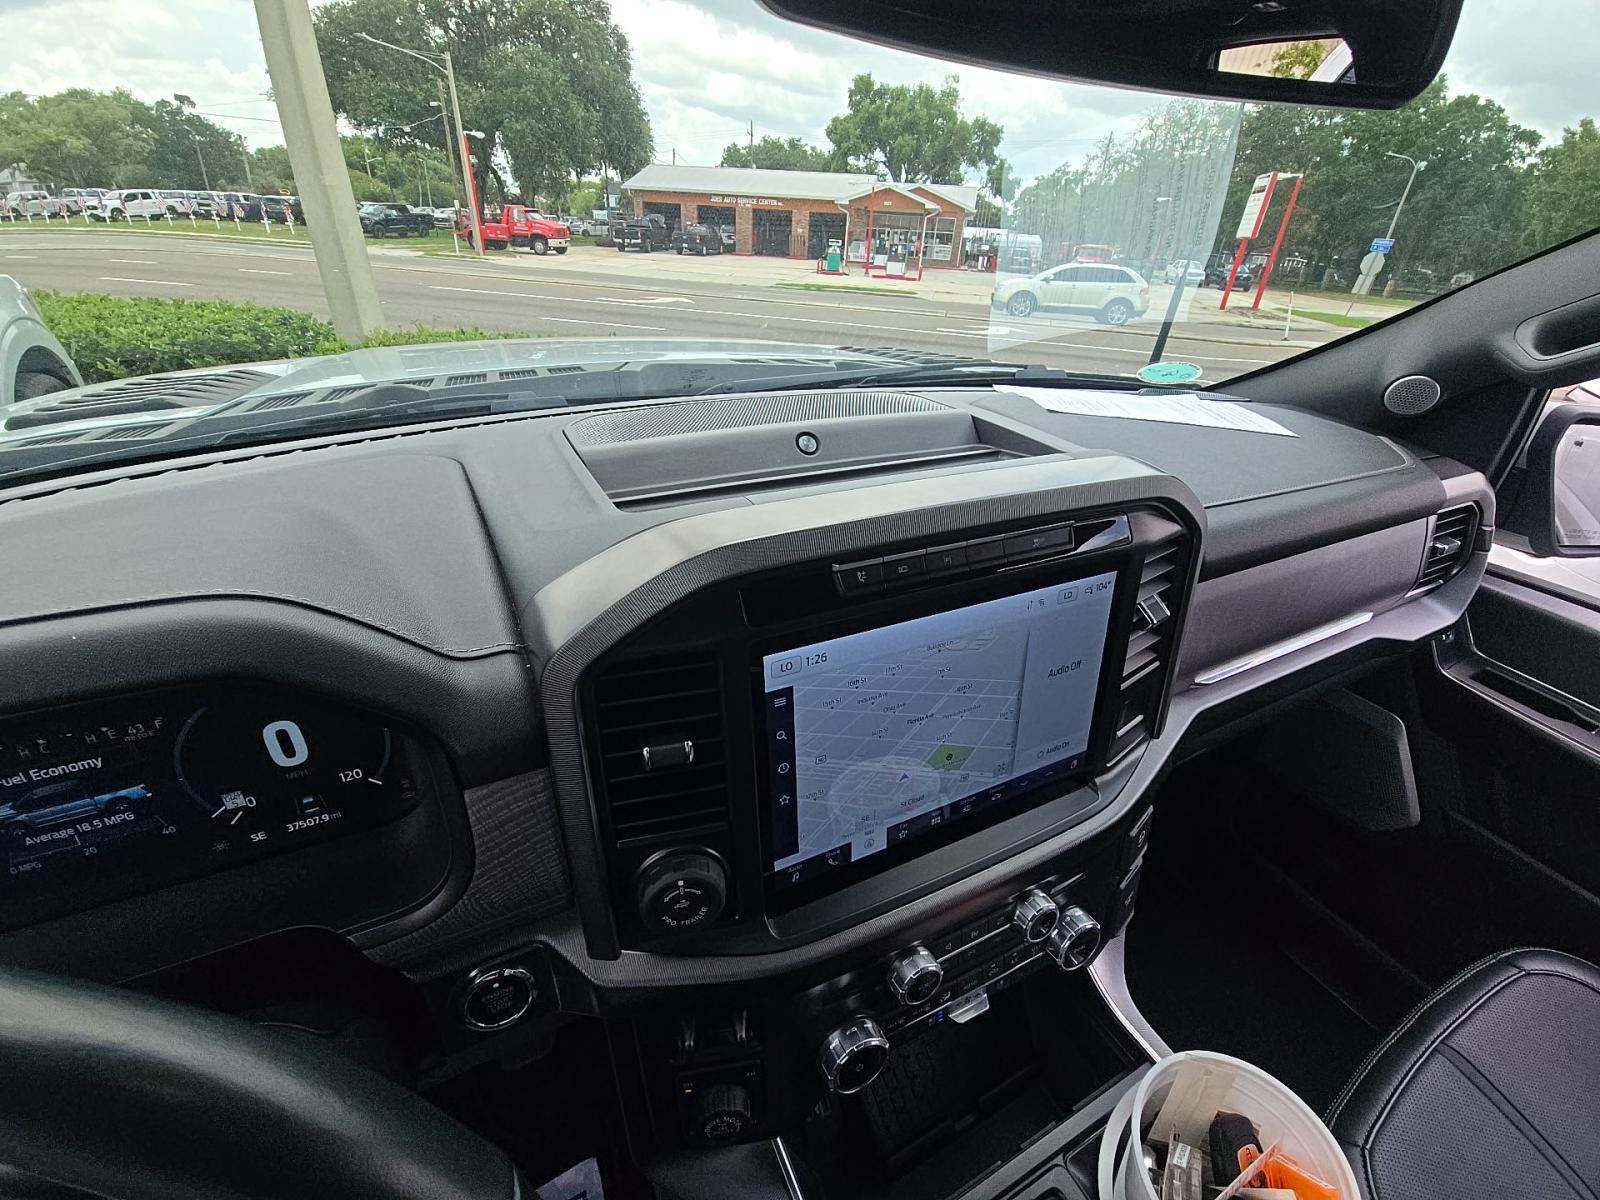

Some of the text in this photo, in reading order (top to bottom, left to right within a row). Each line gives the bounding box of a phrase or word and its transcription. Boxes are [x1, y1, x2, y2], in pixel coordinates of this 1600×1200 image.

[723, 196, 737, 204] AUTO
[758, 198, 778, 206] CENTER
[1063, 591, 1073, 600] LO
[780, 652, 828, 673] LO 1:26
[1047, 658, 1083, 679] Audio Off
[85, 734, 97, 745] H
[107, 729, 116, 740] E
[262, 719, 309, 768] 0
[29, 756, 103, 782] Economy
[337, 767, 364, 784] 120
[25, 811, 136, 847] Average 18.5 MPG
[161, 825, 178, 836] 40
[285, 813, 331, 833] 37507.9
[250, 830, 268, 843] SE
[680, 905, 709, 926] TRAILER
